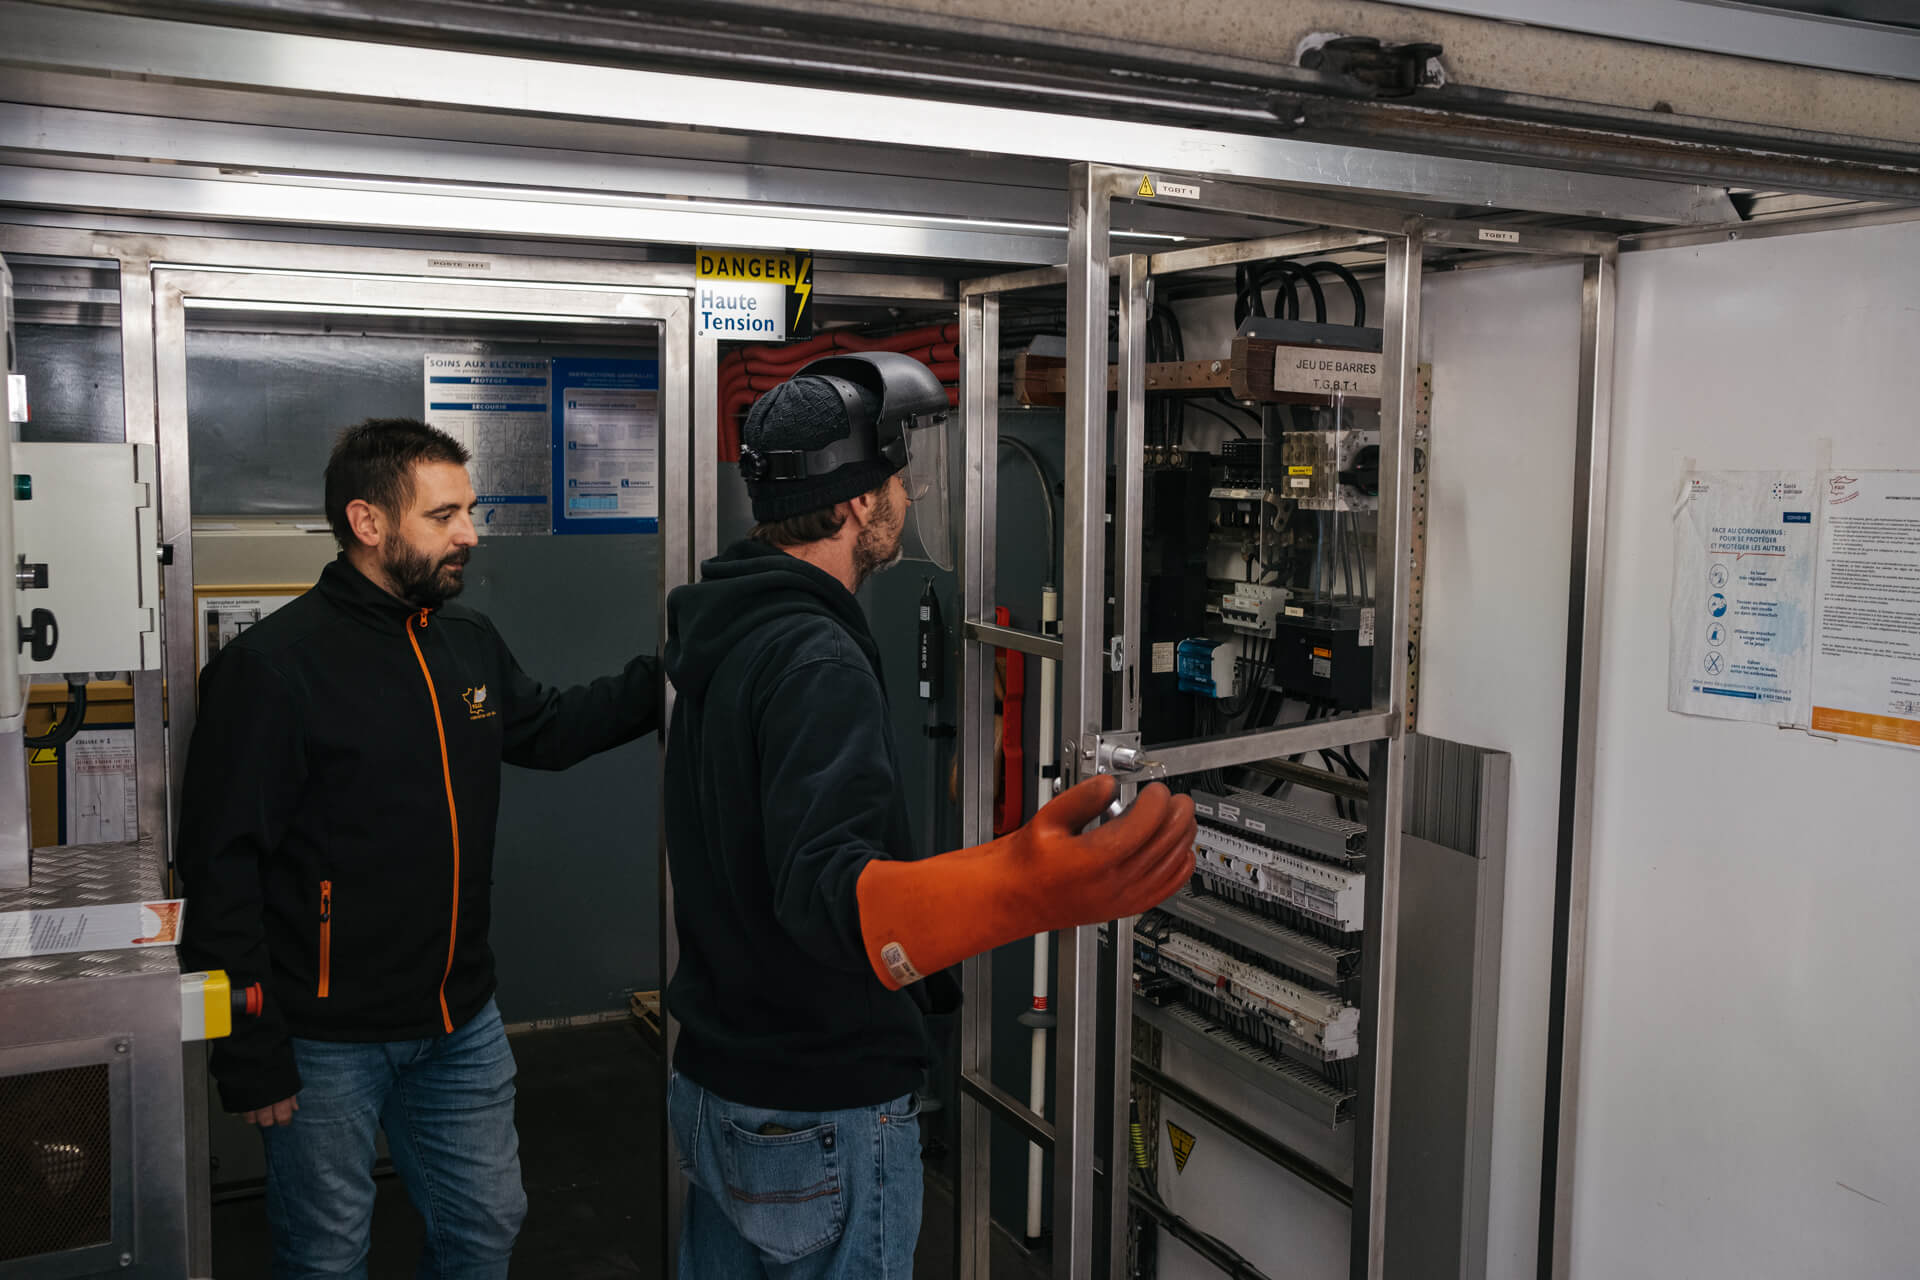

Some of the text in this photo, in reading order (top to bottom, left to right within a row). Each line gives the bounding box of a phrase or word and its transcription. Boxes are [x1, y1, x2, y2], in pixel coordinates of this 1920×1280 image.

[1163, 185, 1187, 194] TGBT
[701, 255, 791, 279] DANGER
[701, 289, 757, 311] Haute
[702, 312, 775, 332] Tension
[430, 360, 461, 368] SOINS
[1296, 360, 1377, 374] JEU DE BARRES
[1738, 528, 1783, 536] CORONAVIRUS
[1763, 544, 1786, 552] AUTRES
